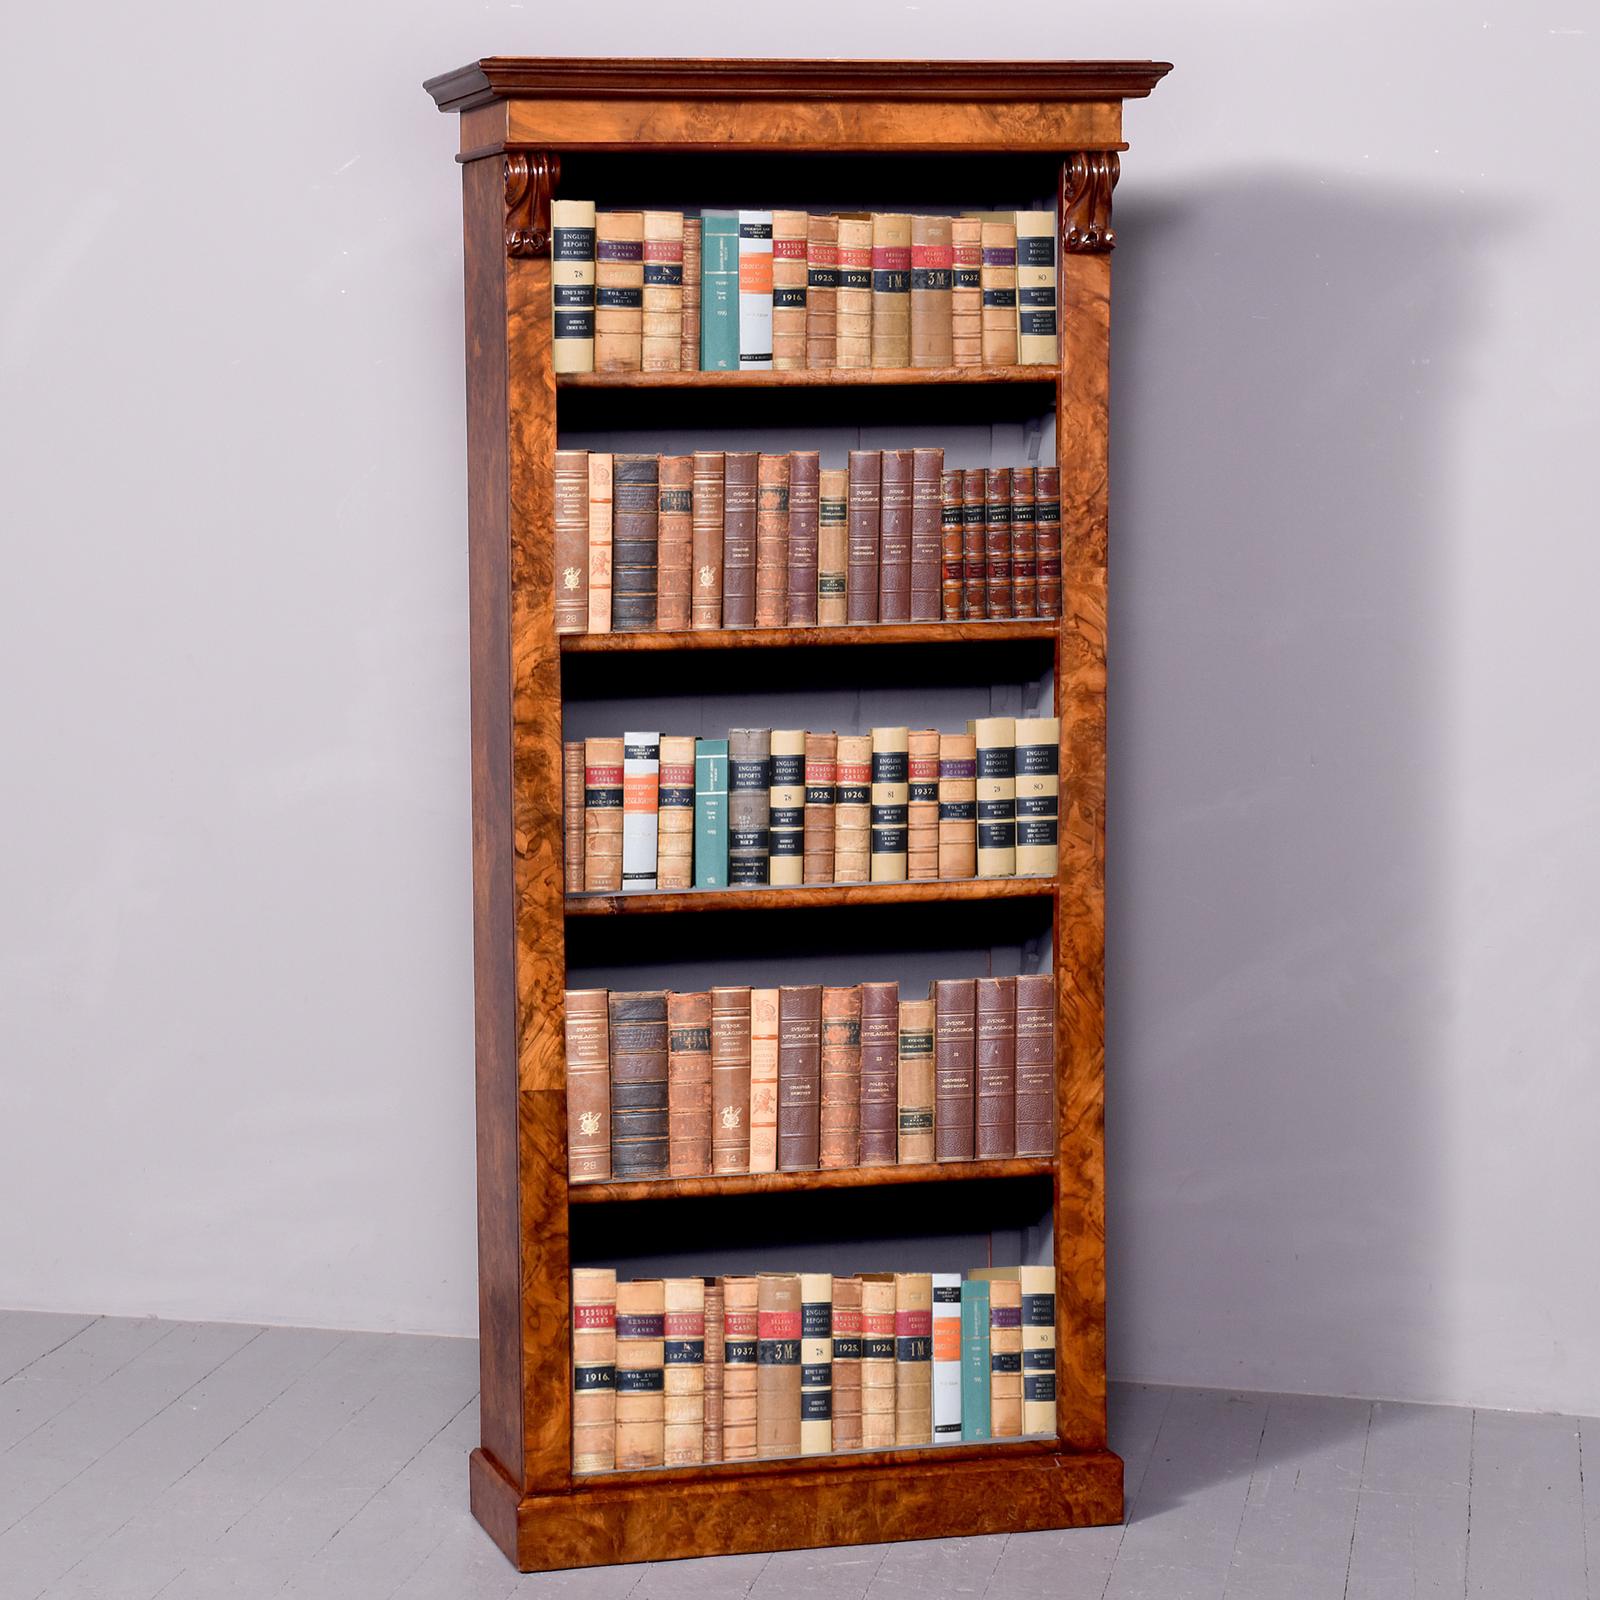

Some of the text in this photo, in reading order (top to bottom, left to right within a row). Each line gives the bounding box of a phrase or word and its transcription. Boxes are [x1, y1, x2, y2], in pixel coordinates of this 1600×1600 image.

[573, 270, 583, 278] 78
[914, 788, 935, 796] 1937.
[580, 1309, 613, 1317] SESSION
[732, 1347, 755, 1356] 1937.
[585, 1373, 610, 1383] 1916.
